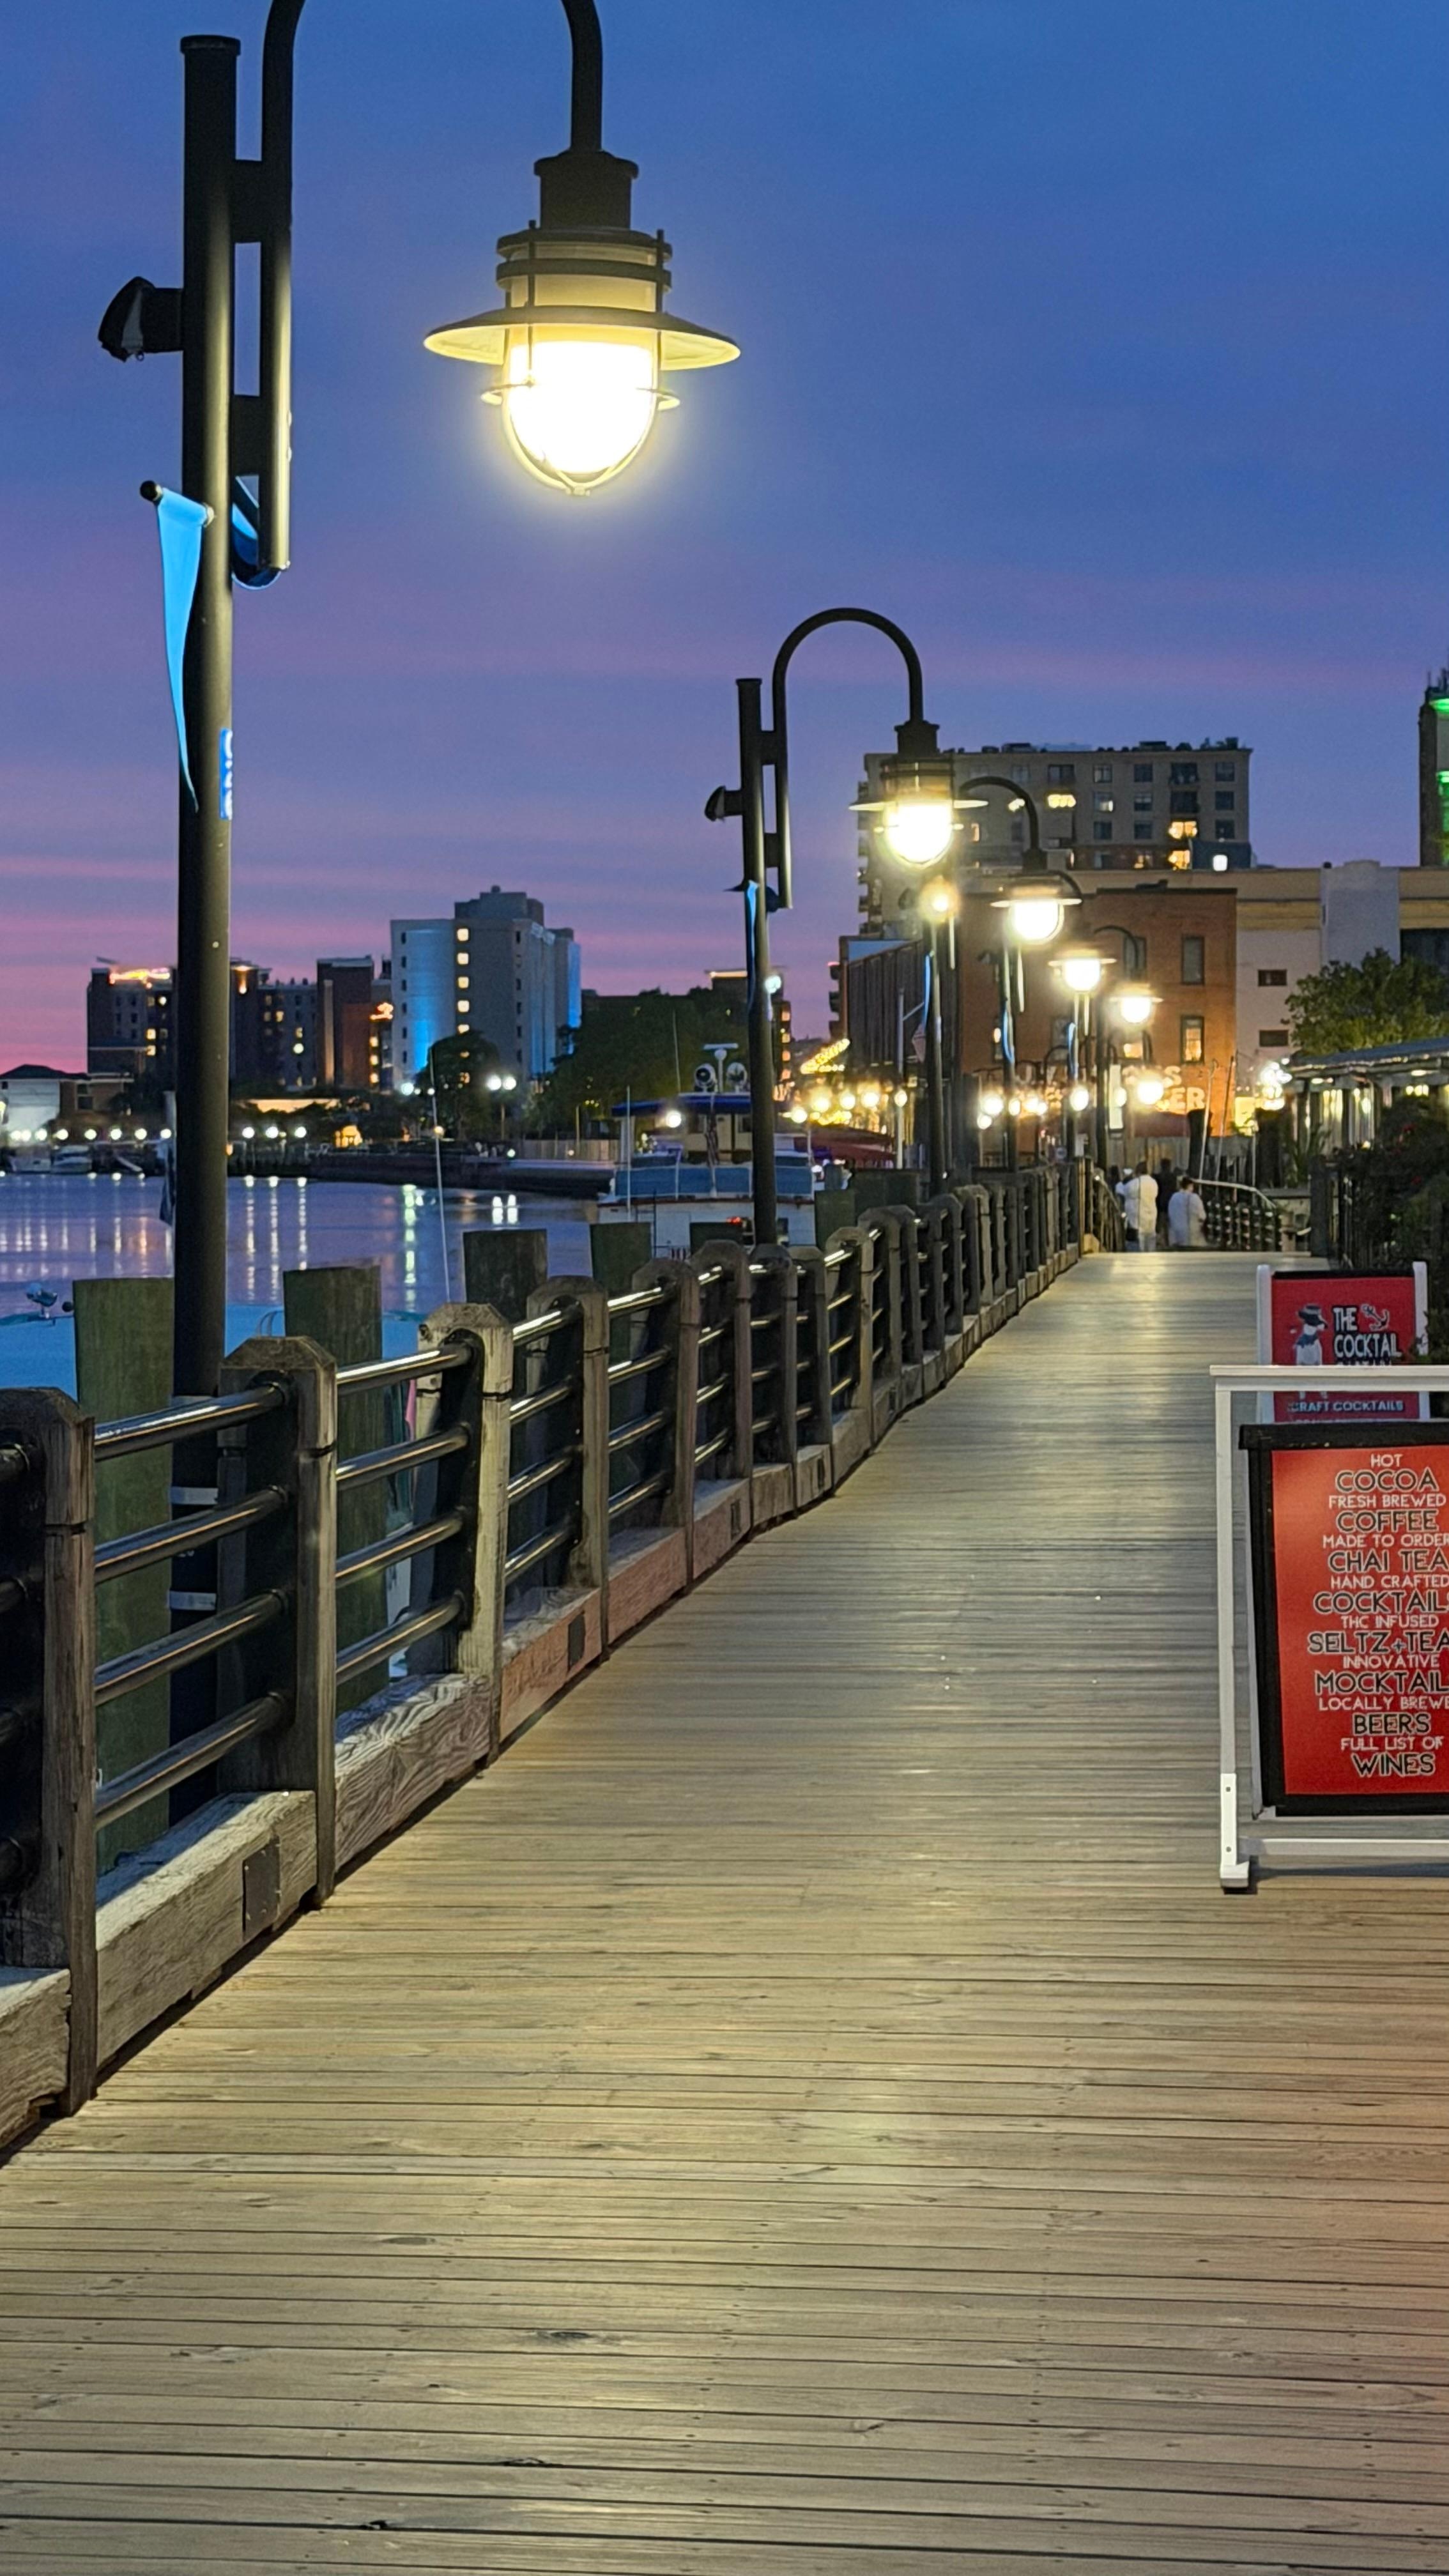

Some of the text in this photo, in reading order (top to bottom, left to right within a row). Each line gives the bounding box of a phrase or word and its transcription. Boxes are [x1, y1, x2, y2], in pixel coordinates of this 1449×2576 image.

[1333, 1307, 1358, 1331] THE
[1333, 1333, 1402, 1358] COCKTAIL
[1333, 1400, 1404, 1411] COCKTAILS
[1370, 1453, 1403, 1467] HOT
[1335, 1467, 1439, 1492] COCOA
[1329, 1493, 1446, 1509] FRESH BREWED
[1336, 1510, 1439, 1533] COFFEE
[1322, 1533, 1449, 1549] MADE TO ORDER
[1328, 1546, 1449, 1572] CHAI TEA
[1331, 1574, 1449, 1589] HAND CRAFTED
[1314, 1588, 1449, 1613] COCKTAIL
[1340, 1614, 1439, 1629] THC INFUSED
[1342, 1654, 1440, 1669] INNOVATIVE
[1314, 1669, 1449, 1696] MOCKTAIL
[1319, 1696, 1393, 1711] LOCALLY
[1352, 1712, 1431, 1736] BEERS
[1340, 1736, 1445, 1751] FULL LIST OF
[1351, 1751, 1436, 1778] WINES
